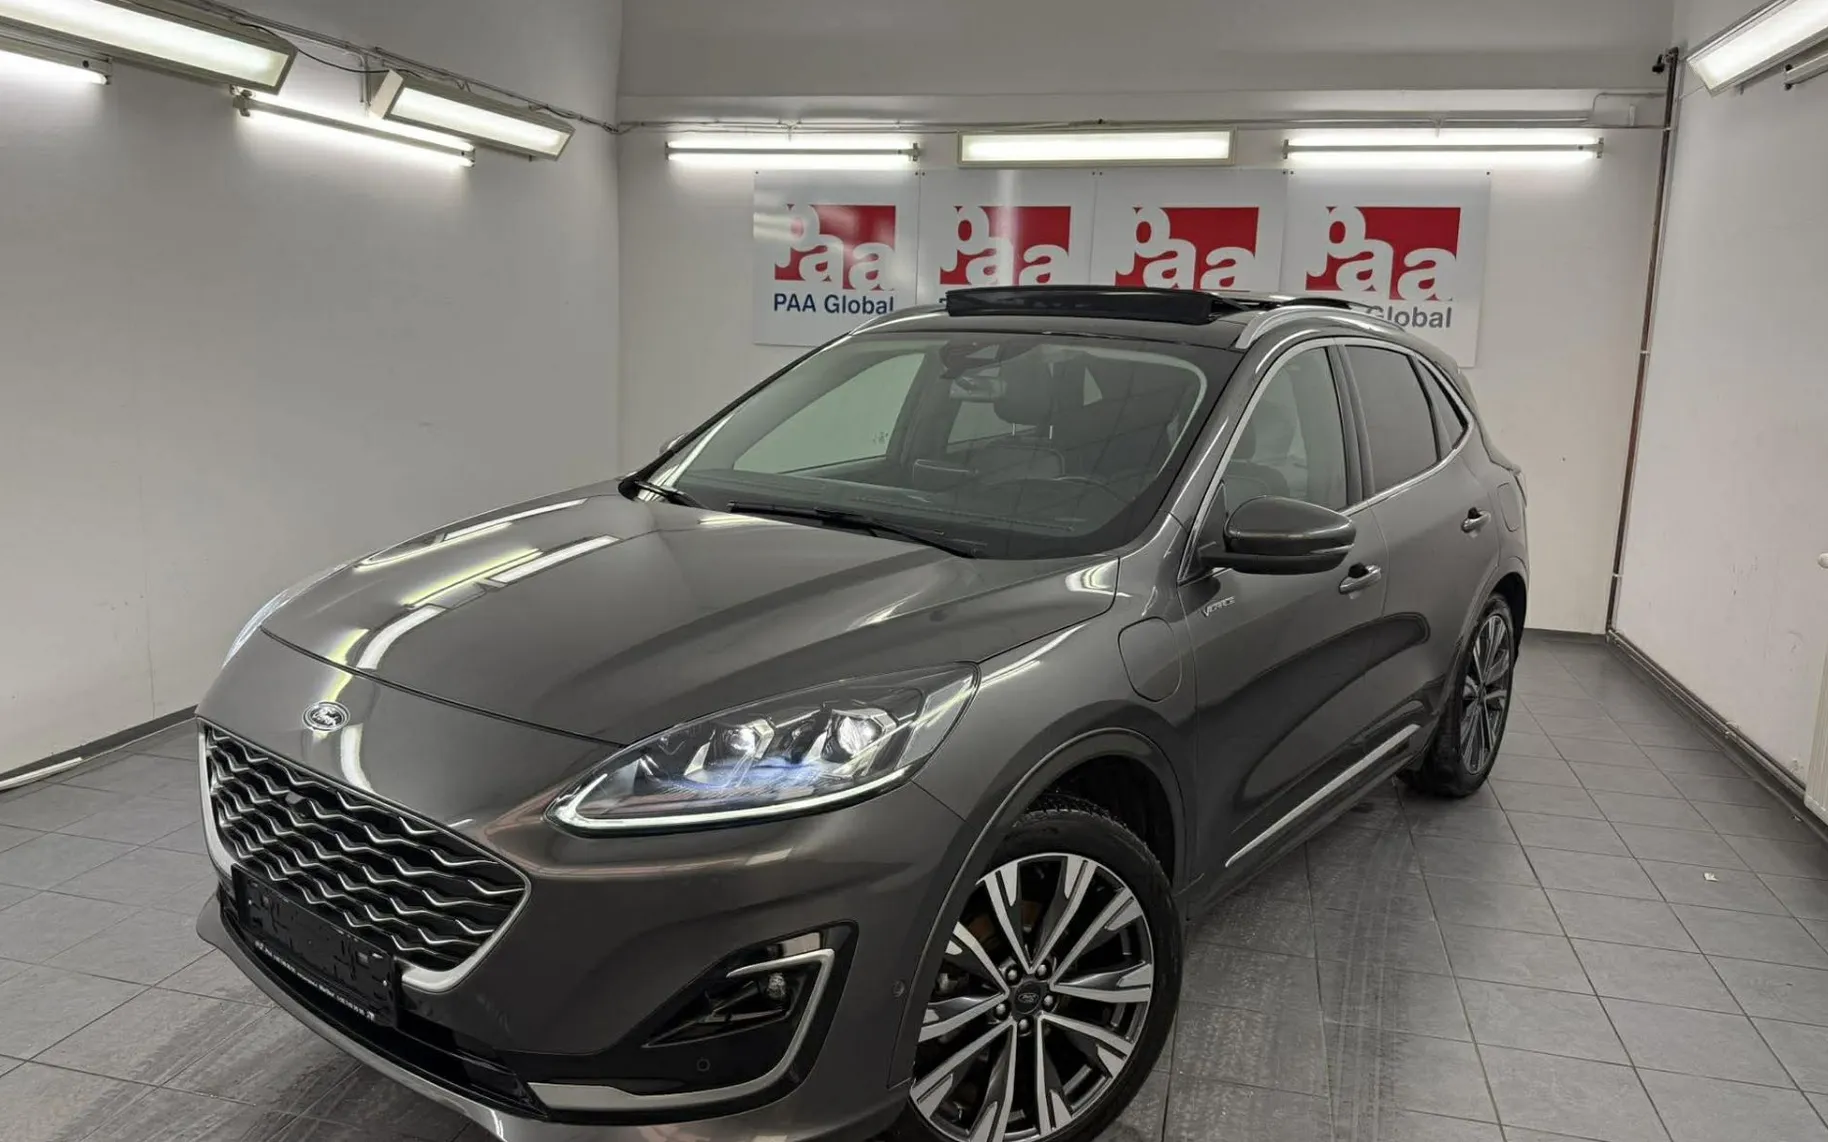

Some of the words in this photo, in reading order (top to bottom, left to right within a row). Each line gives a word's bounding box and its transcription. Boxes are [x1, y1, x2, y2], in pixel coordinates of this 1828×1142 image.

[775, 204, 896, 291] paa
[940, 206, 1071, 286] paa
[1114, 207, 1259, 291] paa
[1305, 207, 1461, 300] paa
[774, 293, 816, 312] PAA
[824, 294, 894, 314] Global
